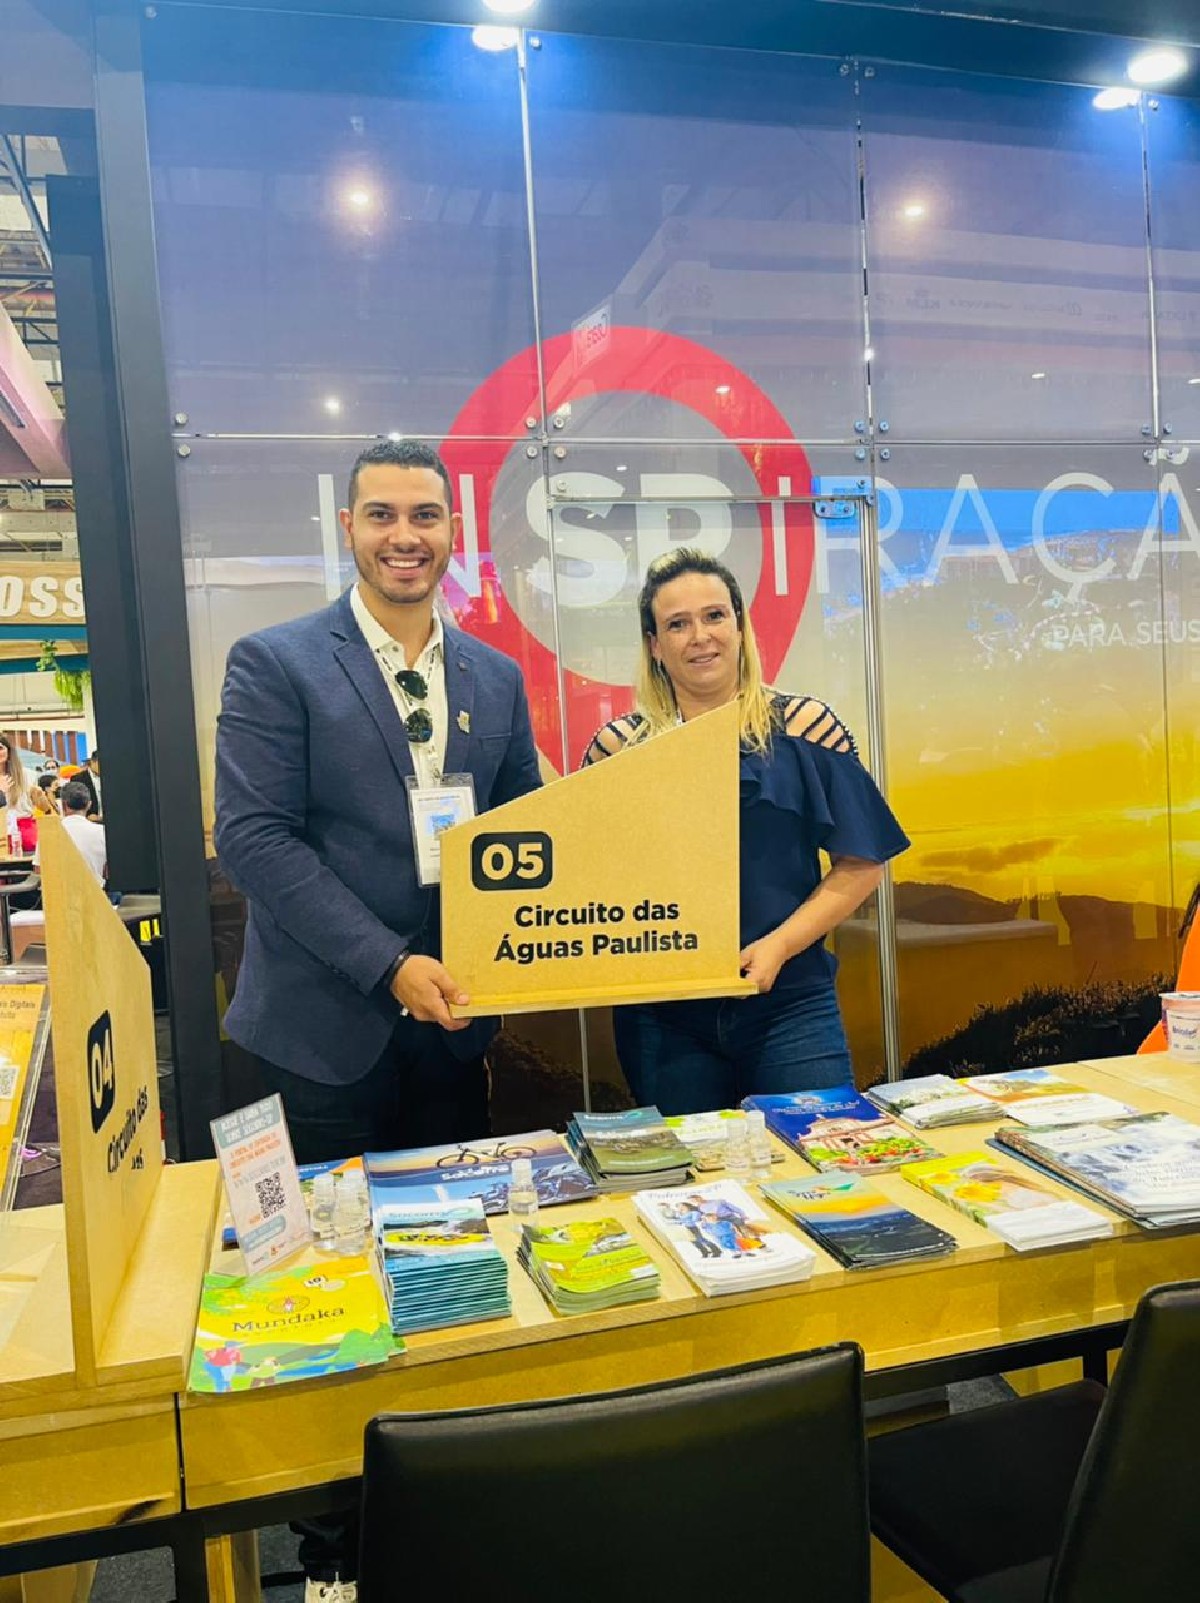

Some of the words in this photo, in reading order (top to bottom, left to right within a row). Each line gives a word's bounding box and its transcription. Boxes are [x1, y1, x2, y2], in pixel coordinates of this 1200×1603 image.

[1051, 620, 1127, 649] PARA
[1136, 619, 1200, 645] SEUS
[480, 842, 545, 881] 05
[514, 901, 625, 928] Circuito
[632, 899, 680, 921] das
[493, 933, 584, 964] Águas
[592, 930, 698, 956] Paulista
[91, 1028, 113, 1110] 04
[233, 1306, 345, 1333] Mundaka
